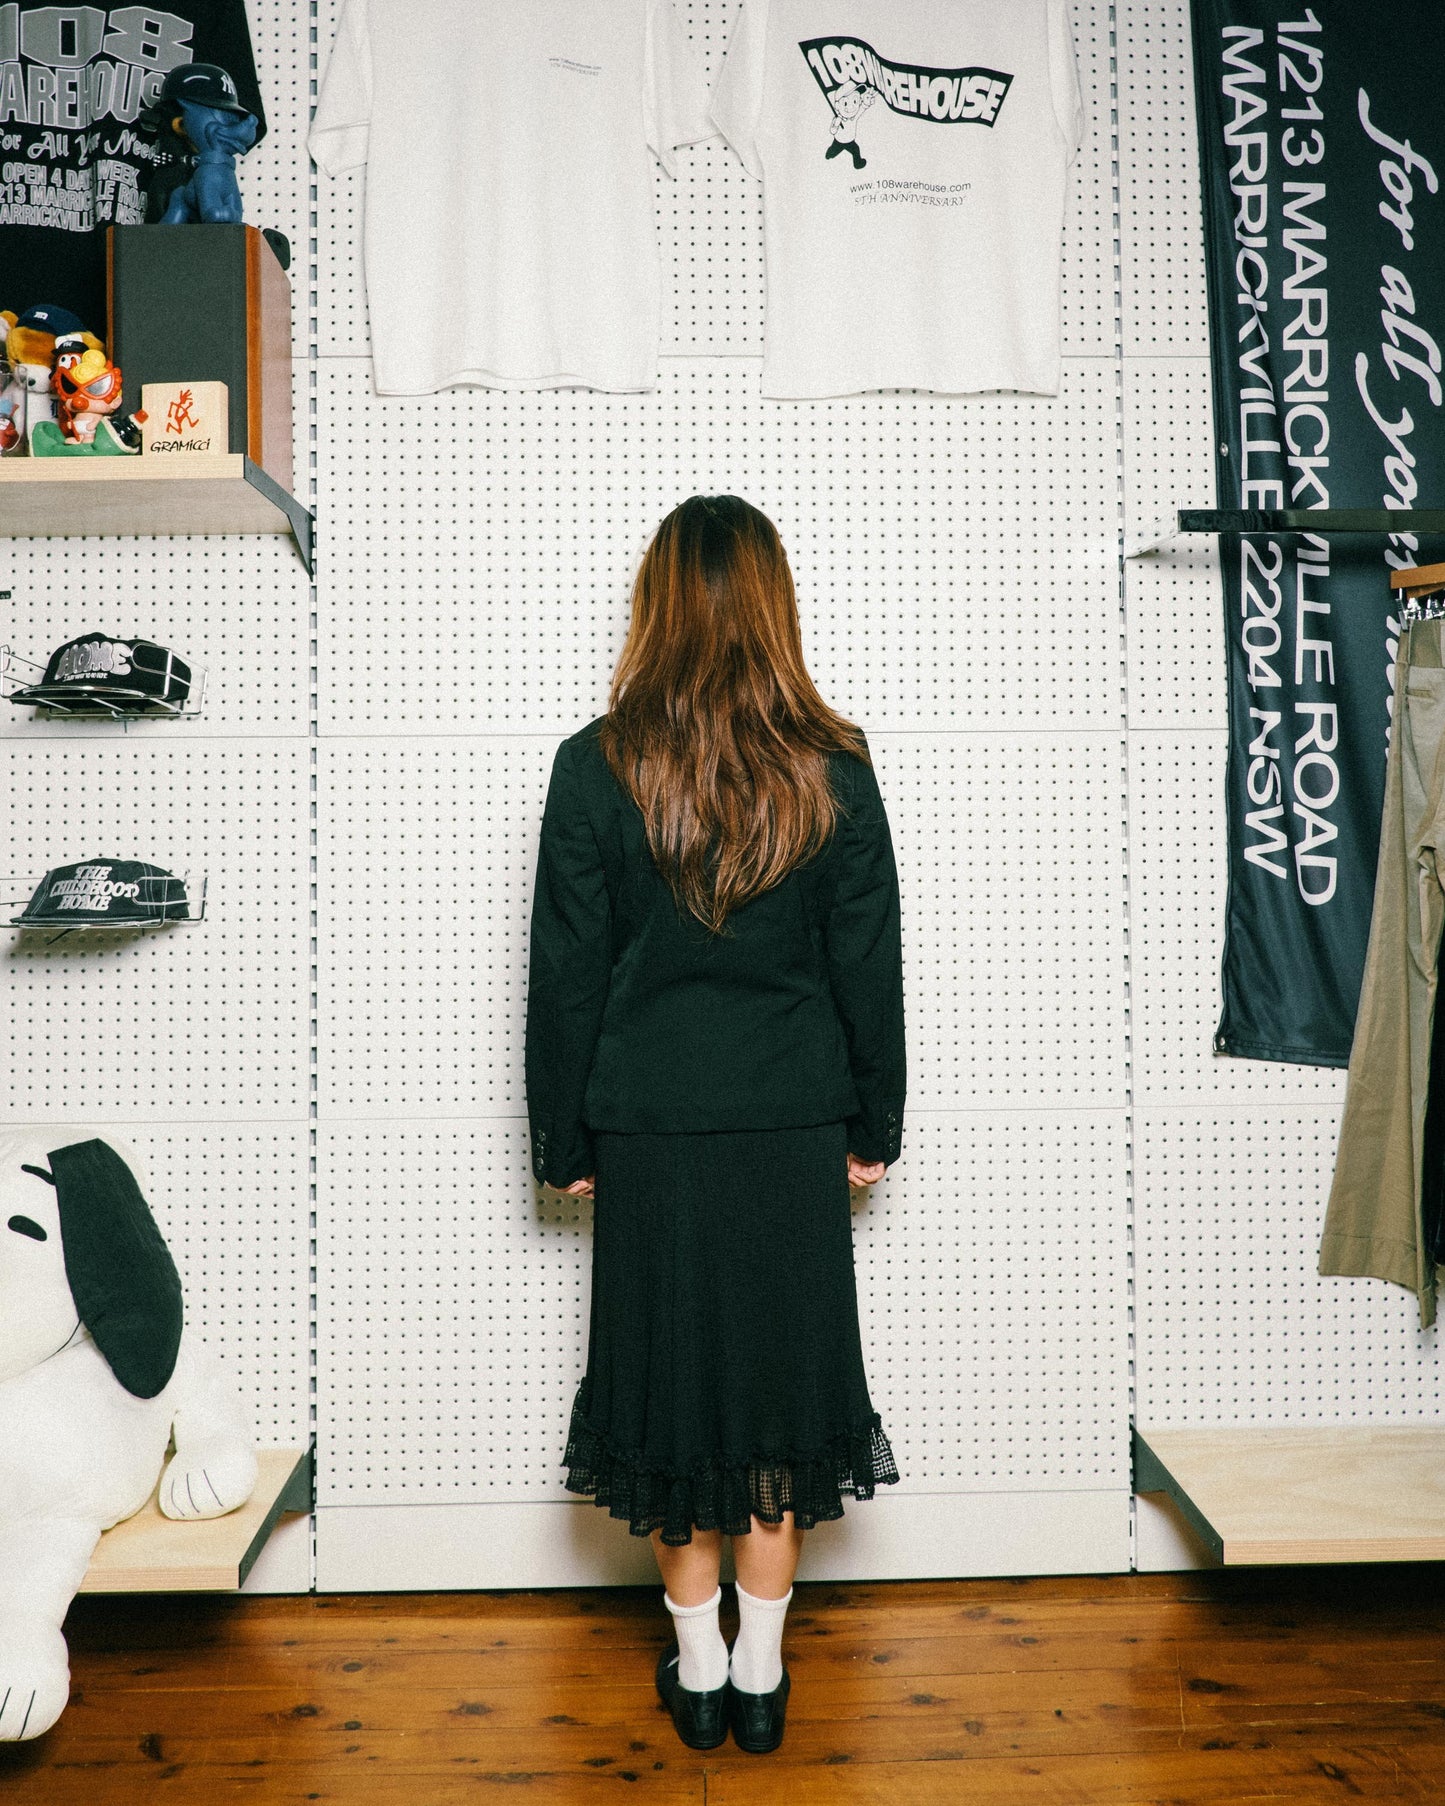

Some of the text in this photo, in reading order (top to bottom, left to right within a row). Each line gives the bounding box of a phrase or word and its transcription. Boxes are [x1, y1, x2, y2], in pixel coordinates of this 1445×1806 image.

[1277, 8, 1325, 167] 1/213
[27, 131, 69, 160] All
[2, 161, 47, 185] OPEN
[50, 167, 62, 188] 4
[97, 159, 140, 189] WEEK
[1357, 86, 1439, 251] for
[118, 182, 148, 212] ROA
[849, 179, 972, 194] www.108warehouse.com
[879, 189, 968, 207] ANNIVERSARY
[1379, 264, 1443, 407] all
[1221, 25, 1288, 880] MARRICKVILLE 2204 NSW
[1293, 702, 1340, 906] ROAD
[74, 865, 113, 881] THE
[50, 879, 140, 898] CHILDHOOD
[57, 895, 113, 911] HOME
